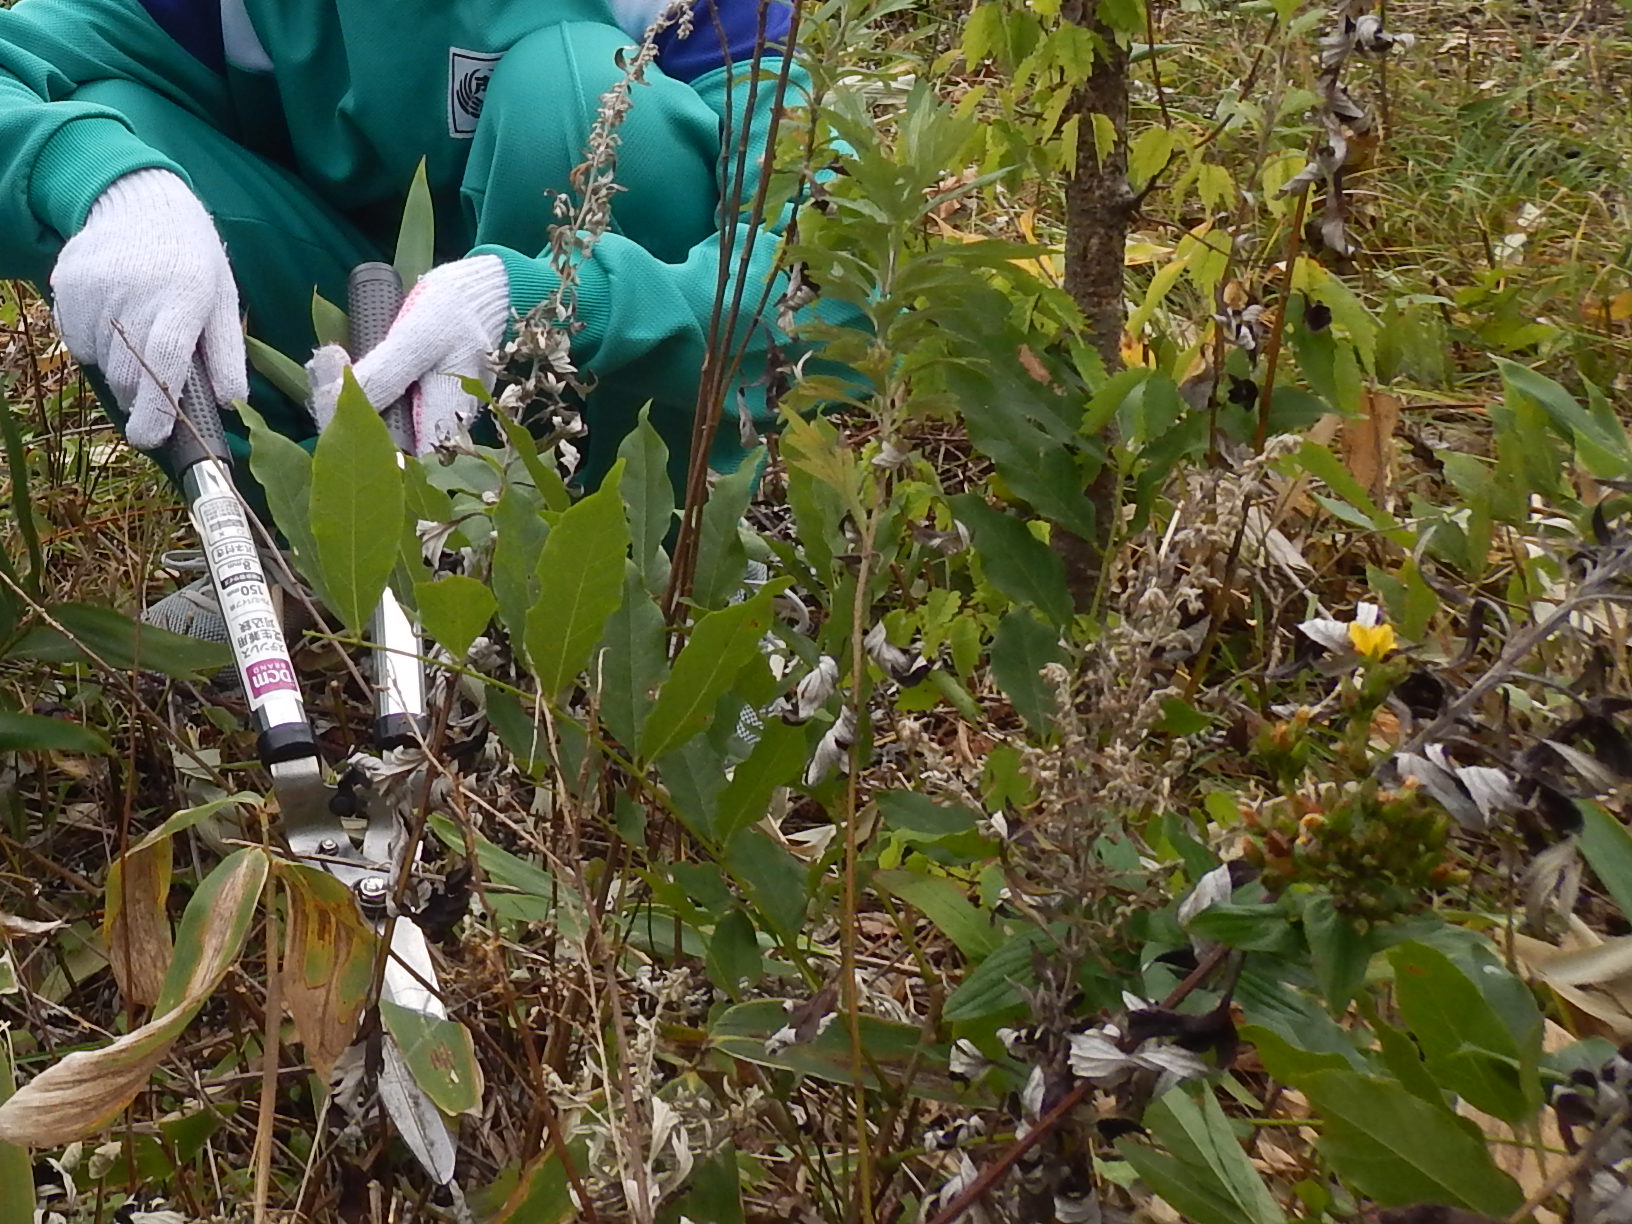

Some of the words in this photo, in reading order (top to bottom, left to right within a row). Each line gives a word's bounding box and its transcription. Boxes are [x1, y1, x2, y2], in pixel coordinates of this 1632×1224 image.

[241, 642, 285, 659] ステンレス
[253, 662, 286, 674] BRAND
